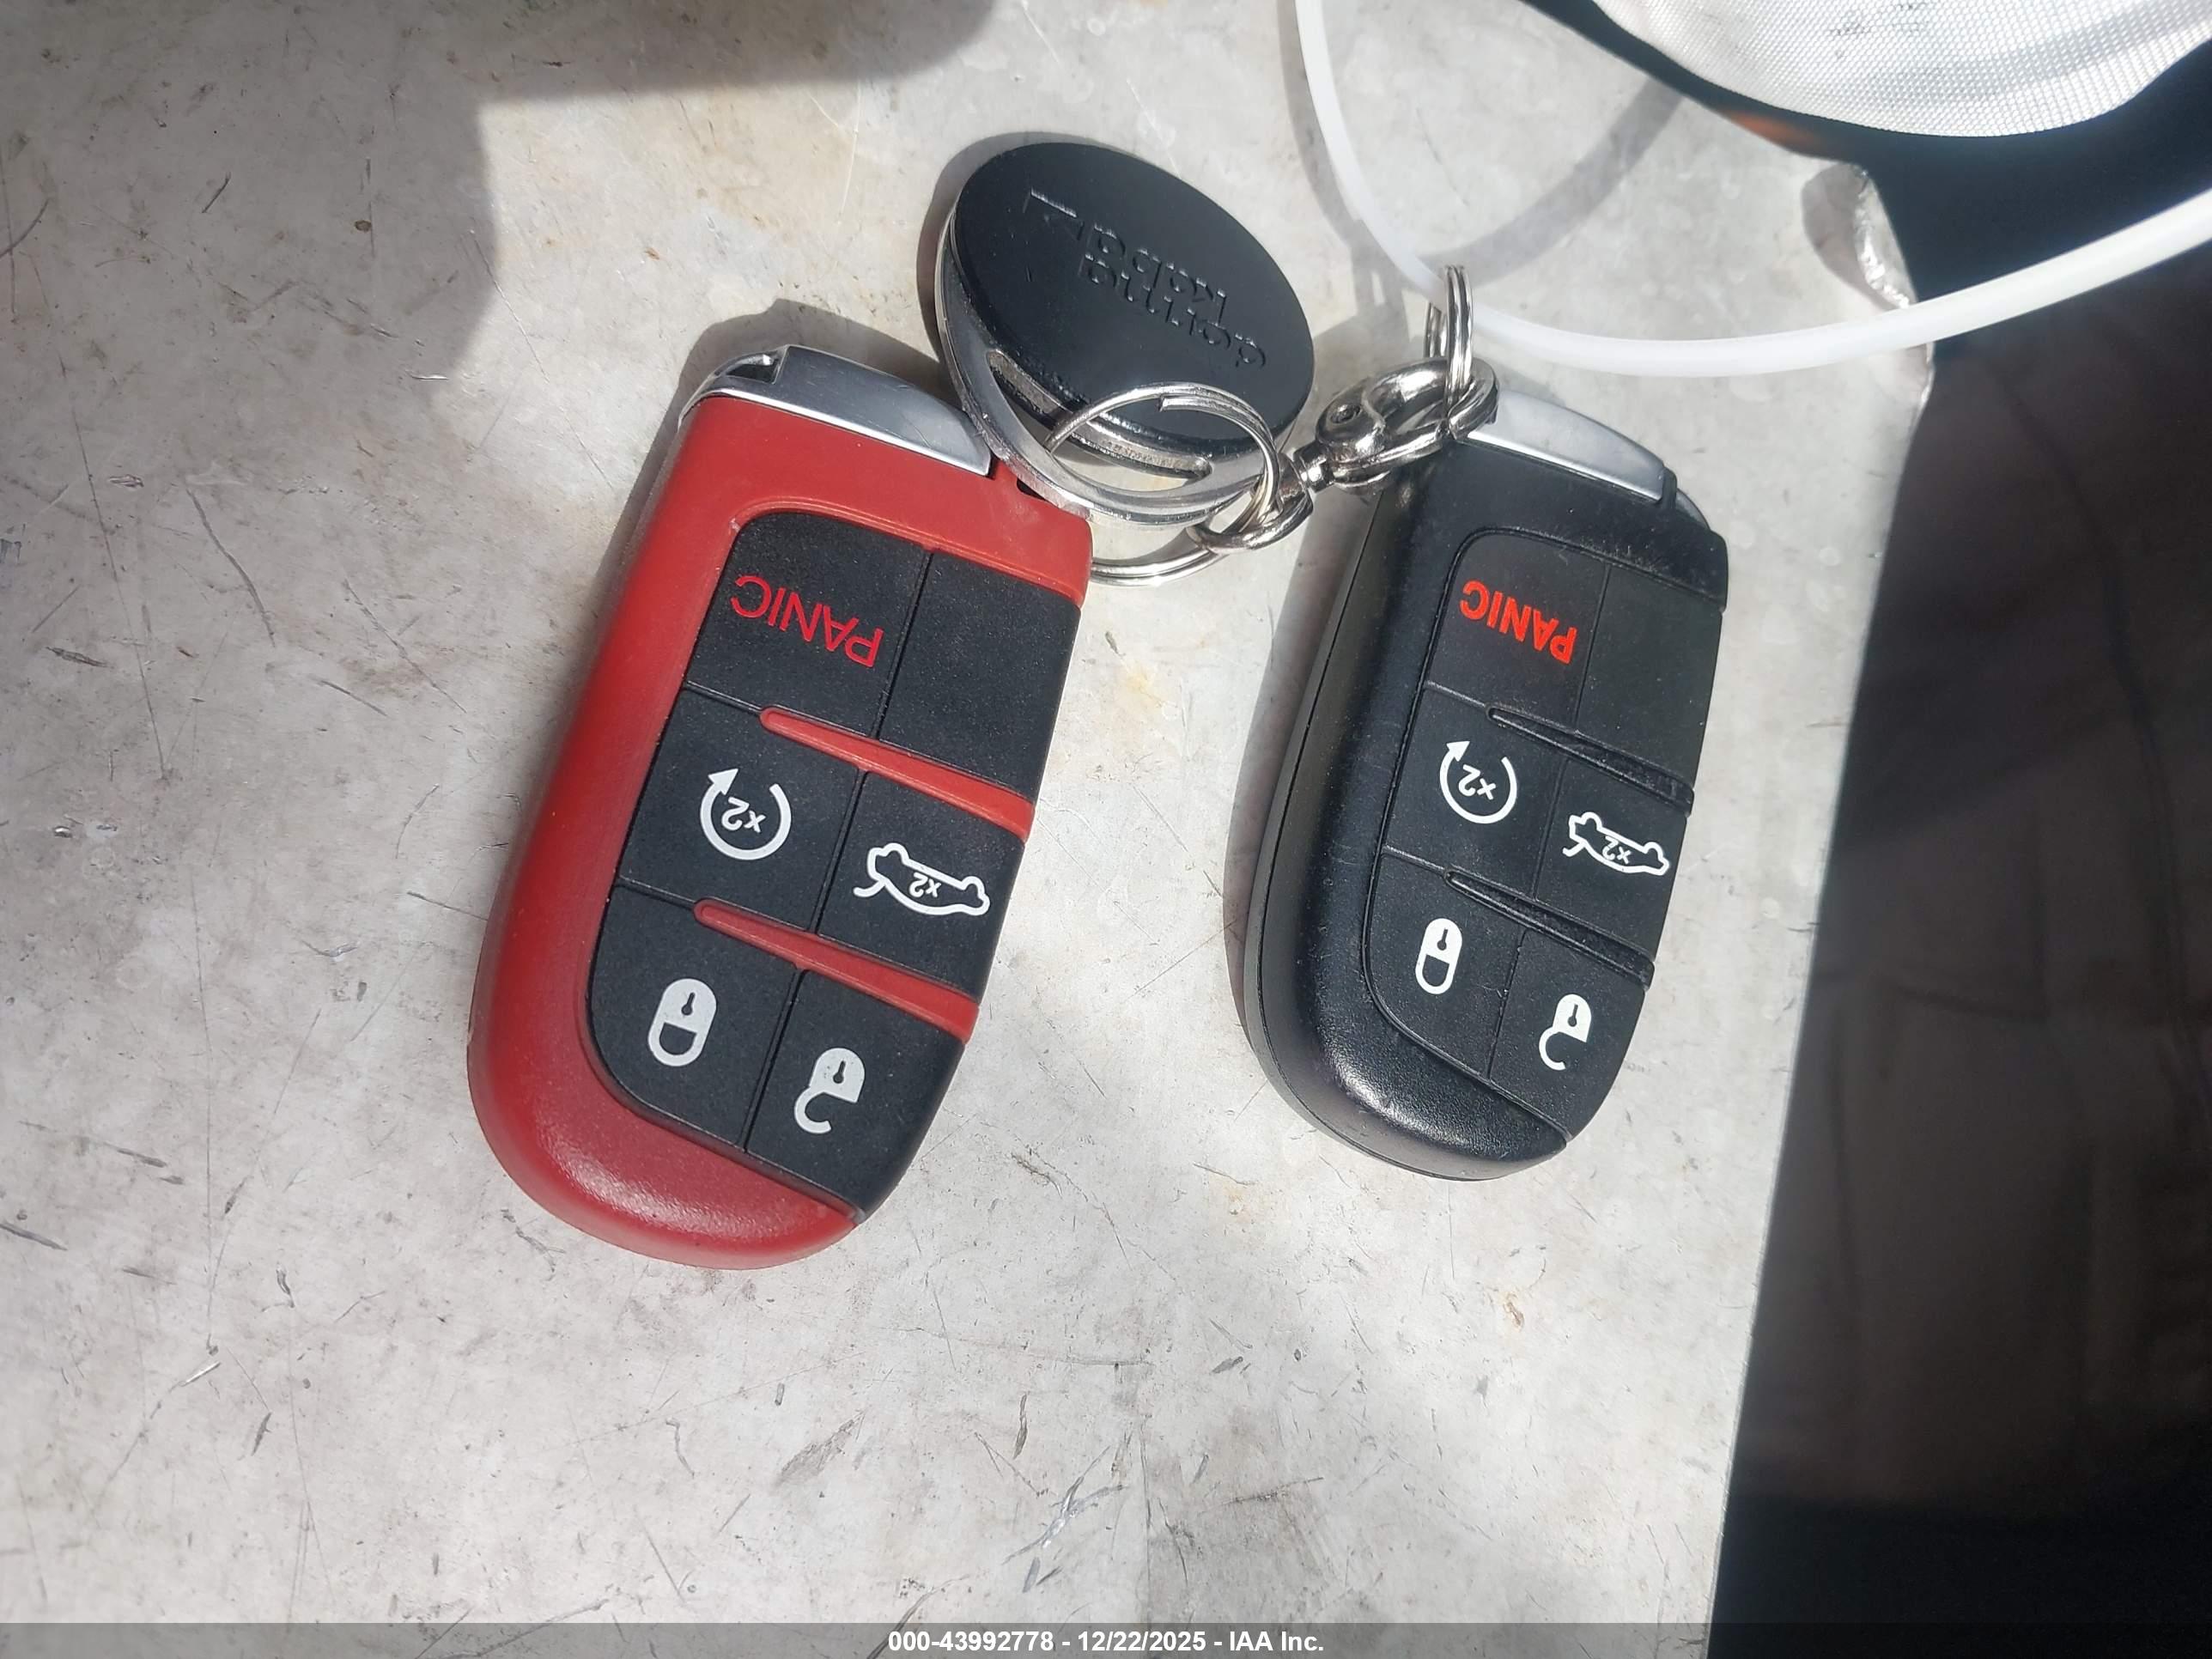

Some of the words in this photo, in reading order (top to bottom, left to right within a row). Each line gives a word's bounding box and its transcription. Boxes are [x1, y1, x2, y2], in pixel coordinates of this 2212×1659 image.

[731, 573, 885, 669] PANIC
[1459, 579, 1578, 665] PANIC
[1458, 763, 1497, 801] x2
[720, 796, 767, 834] x2
[1601, 835, 1632, 866] x2
[908, 871, 943, 898] x2
